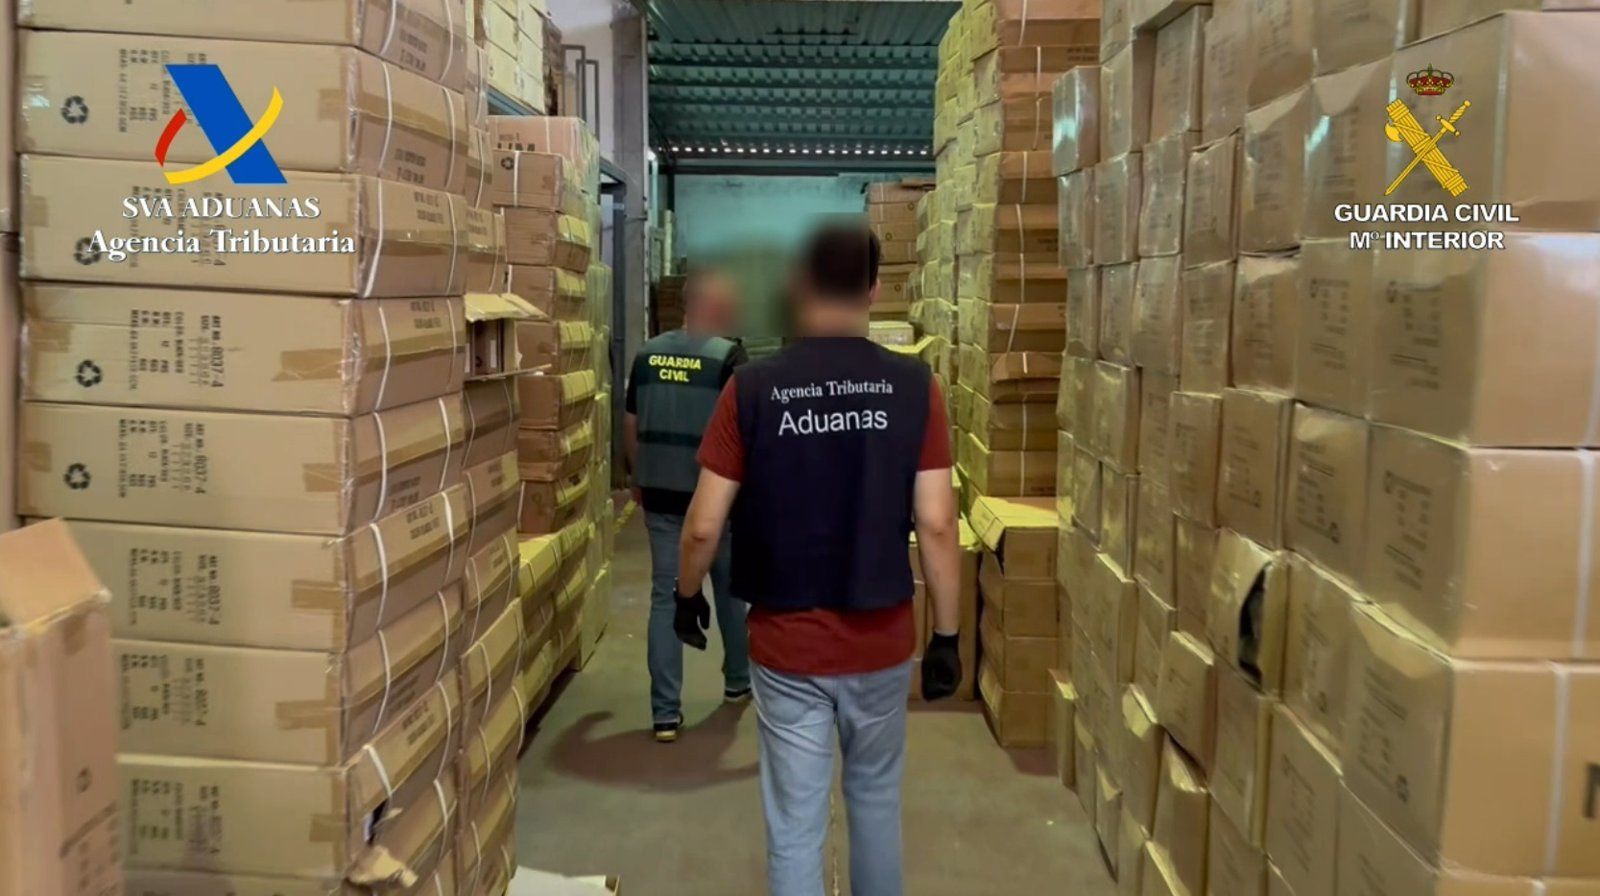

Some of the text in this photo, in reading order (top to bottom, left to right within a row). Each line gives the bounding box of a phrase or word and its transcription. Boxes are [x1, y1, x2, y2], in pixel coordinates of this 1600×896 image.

[648, 354, 702, 370] GUARDIA
[659, 369, 690, 382] CIVIL
[771, 379, 894, 404] Agencia Tributaria
[778, 408, 889, 436] Aduanas
